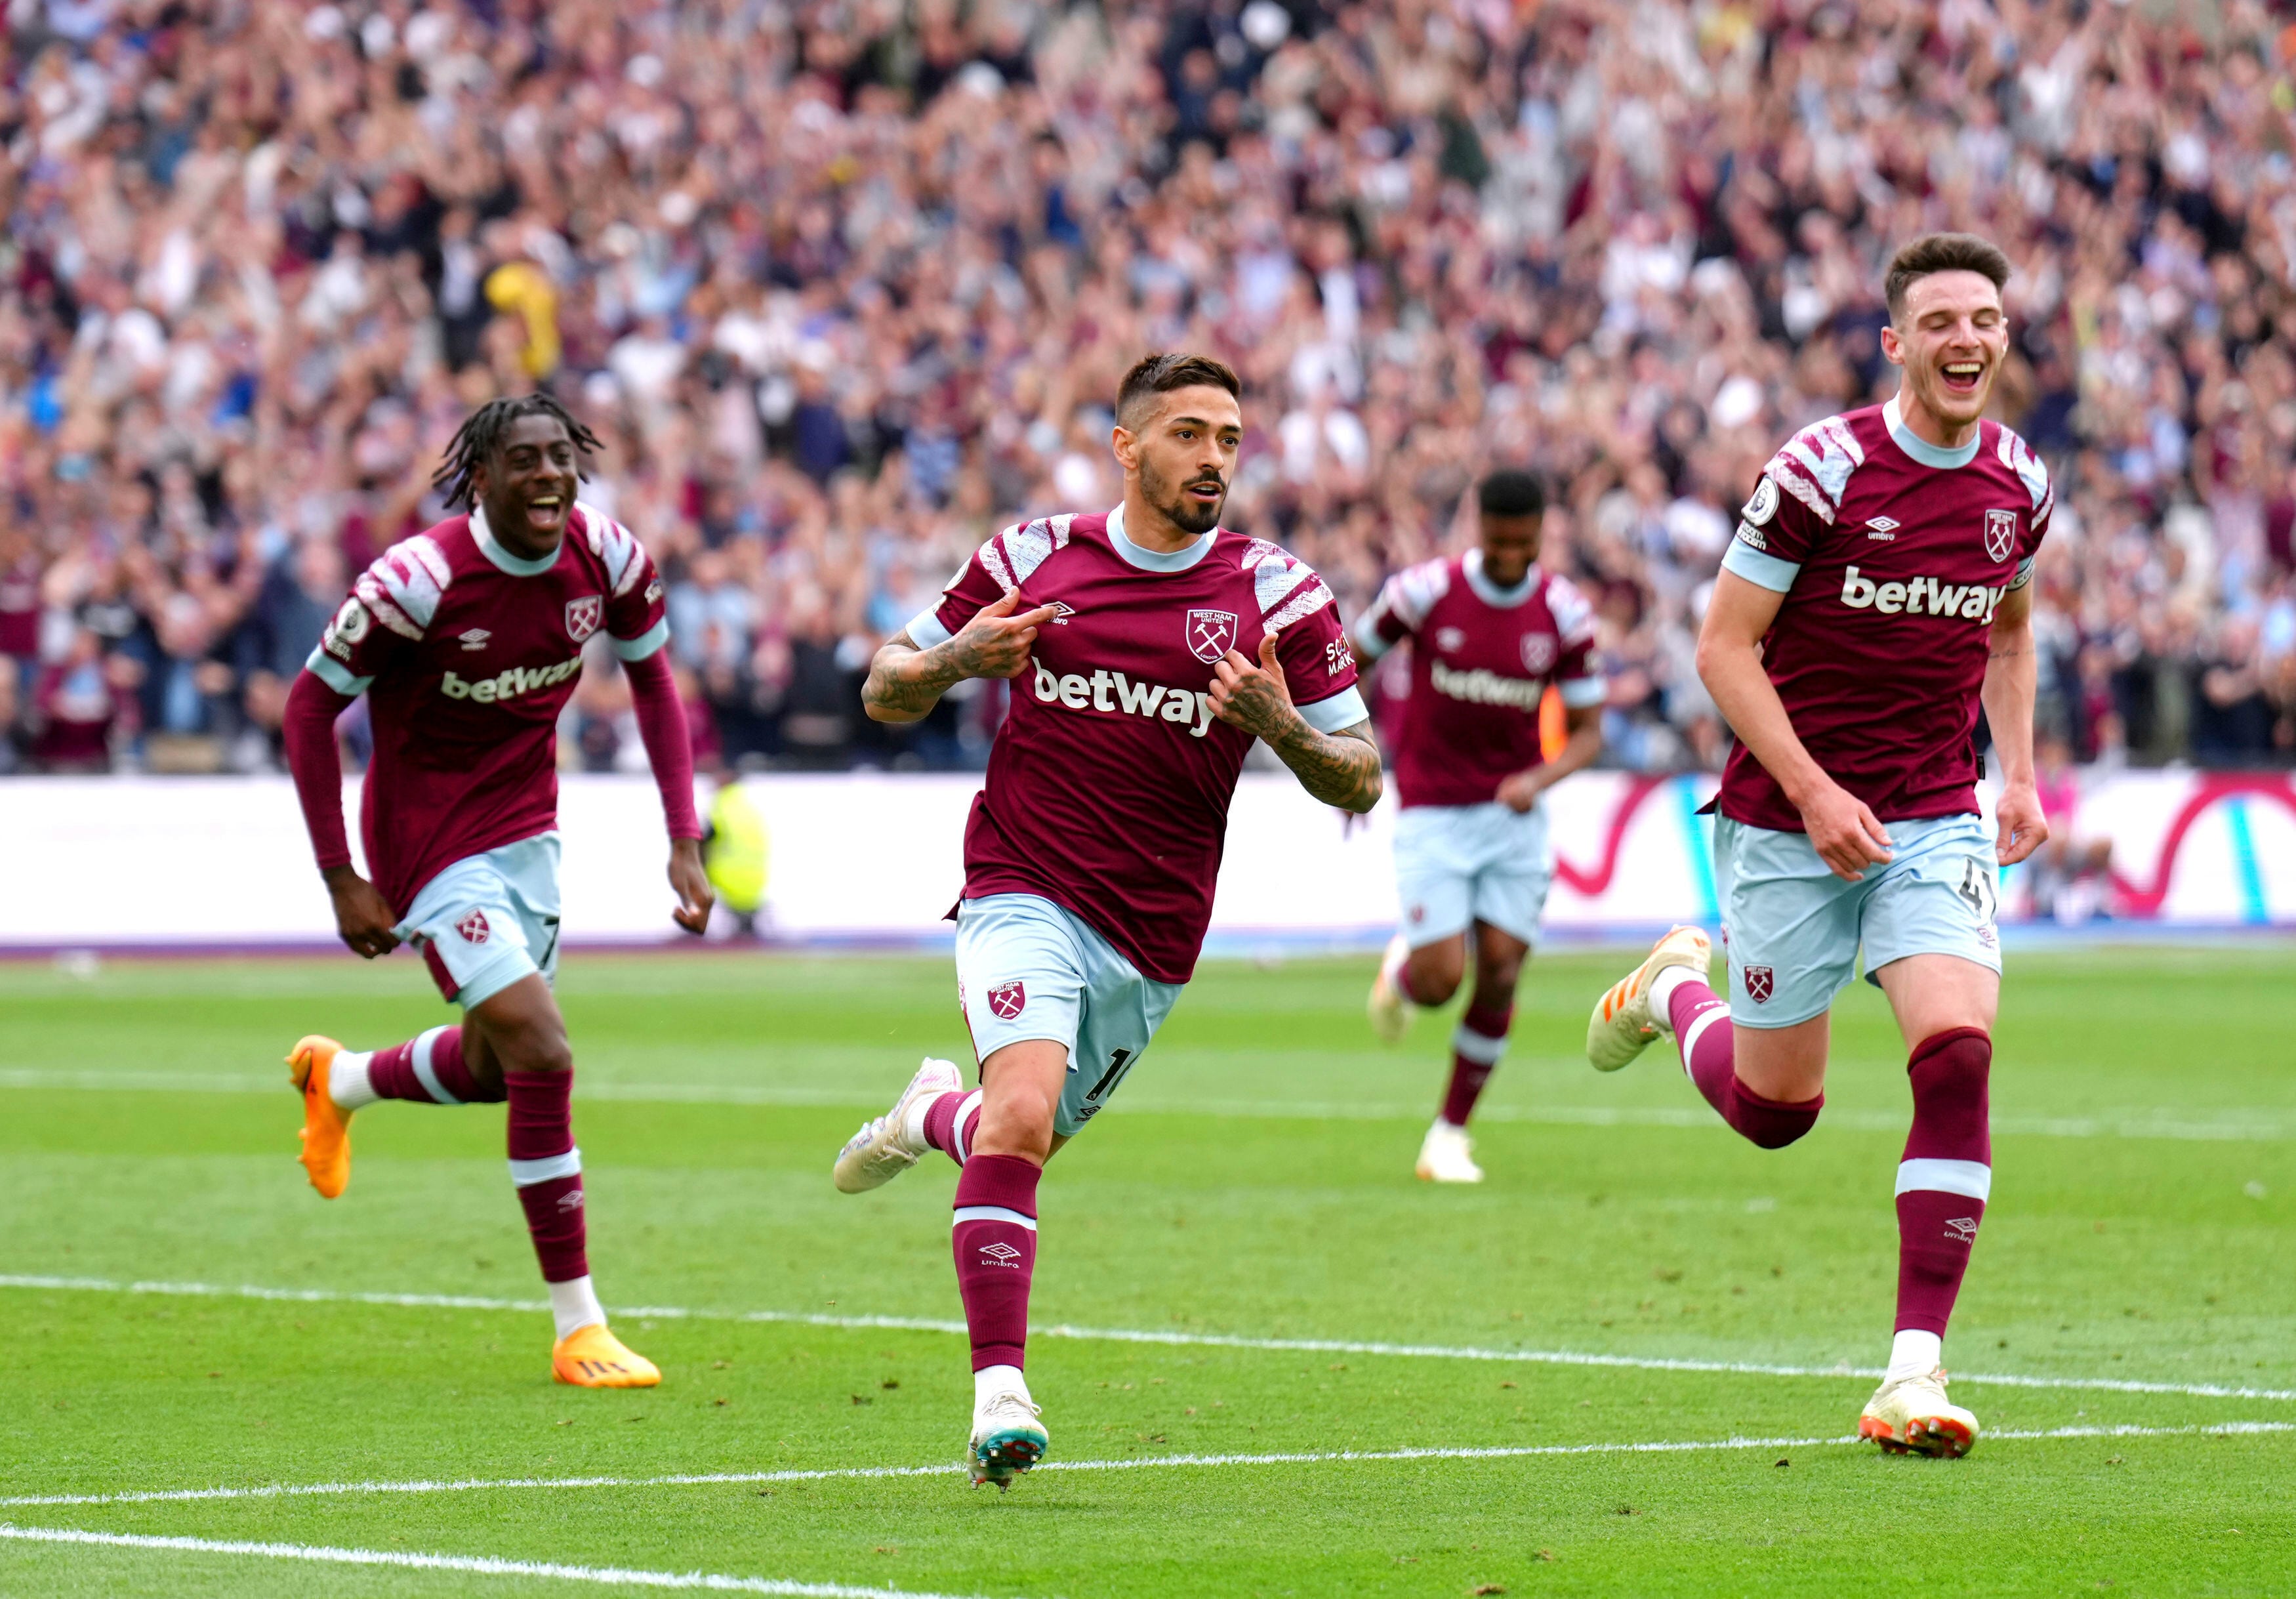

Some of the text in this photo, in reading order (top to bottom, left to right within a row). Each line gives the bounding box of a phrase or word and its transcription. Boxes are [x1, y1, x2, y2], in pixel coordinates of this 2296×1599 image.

[1868, 531, 1895, 541] umbro
[1840, 565, 2007, 625] betway
[1214, 613, 1232, 621] HAM
[1328, 651, 1355, 676] MARK
[1031, 655, 1216, 737] betway
[1958, 858, 1997, 926] 41
[990, 984, 1006, 993] WEST
[981, 1259, 1019, 1269] umbro
